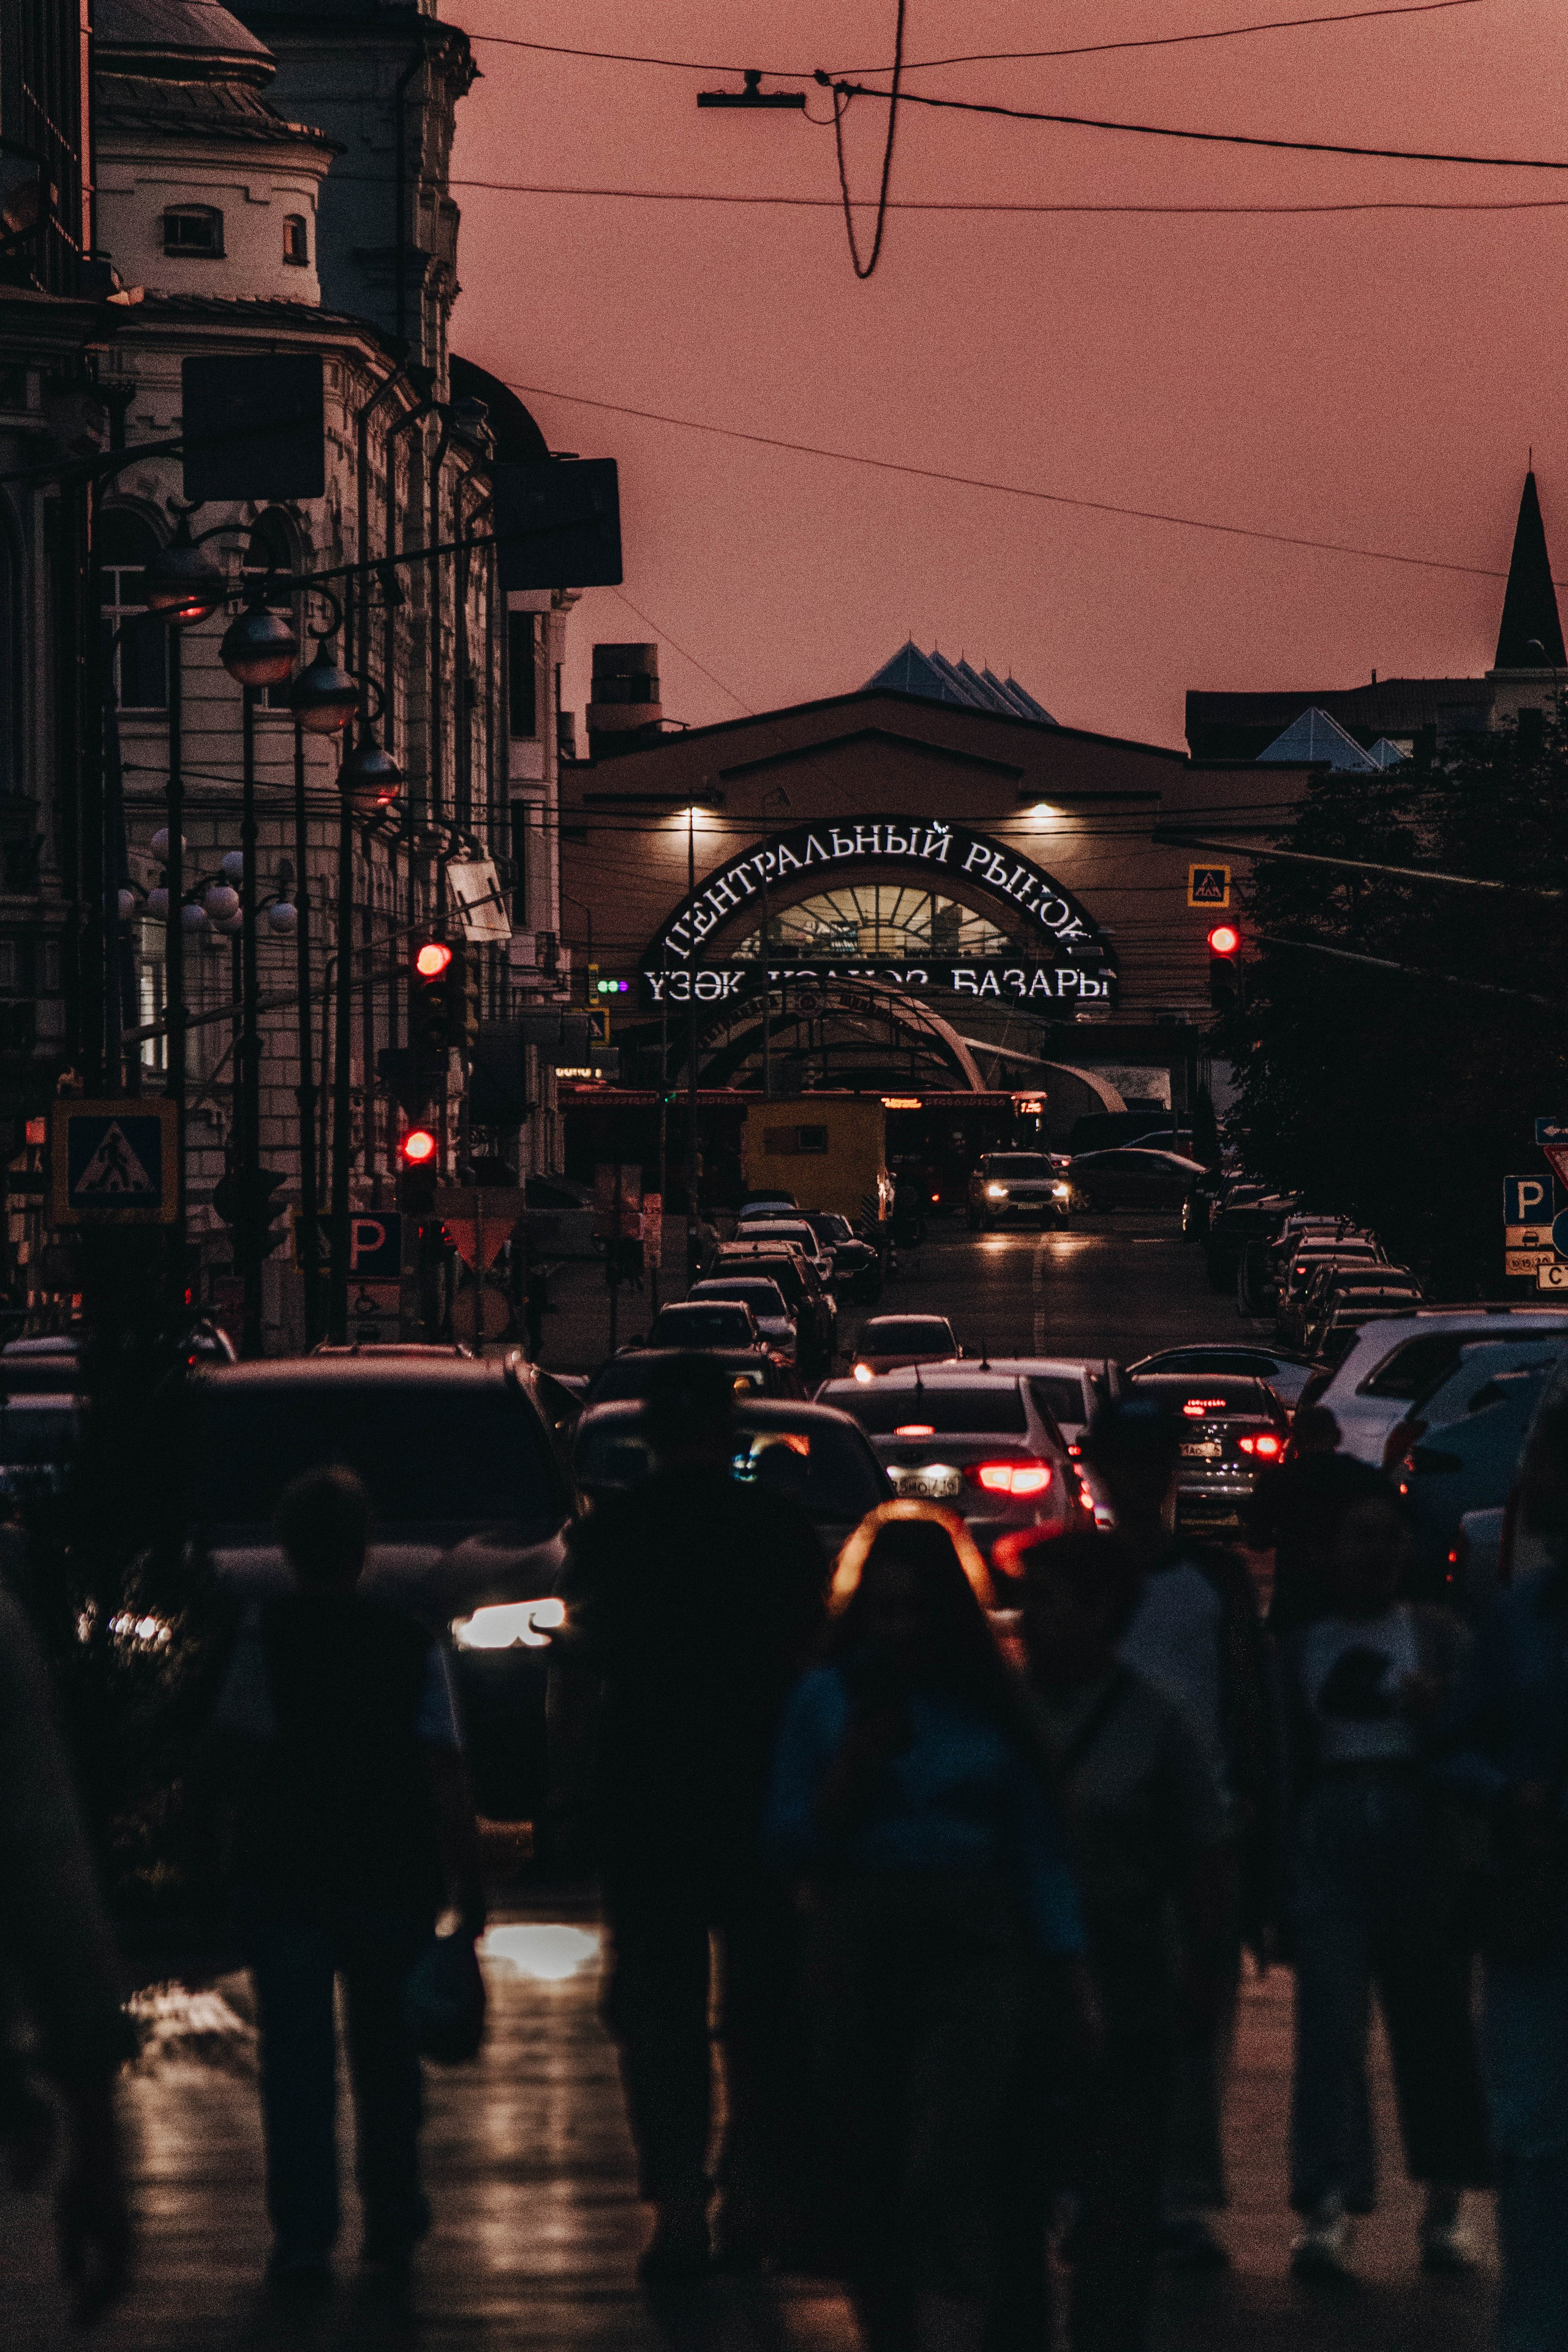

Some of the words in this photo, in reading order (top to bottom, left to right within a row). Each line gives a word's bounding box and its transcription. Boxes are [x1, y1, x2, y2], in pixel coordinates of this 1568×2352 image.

[665, 820, 954, 960] ЦЕНТРАЛЬНЫЙ
[961, 842, 1093, 955] РЫНОК
[951, 968, 1110, 998] БАЗАРЫ
[1517, 1181, 1544, 1219] P
[350, 1218, 386, 1270] P
[1549, 1266, 1568, 1285] С
